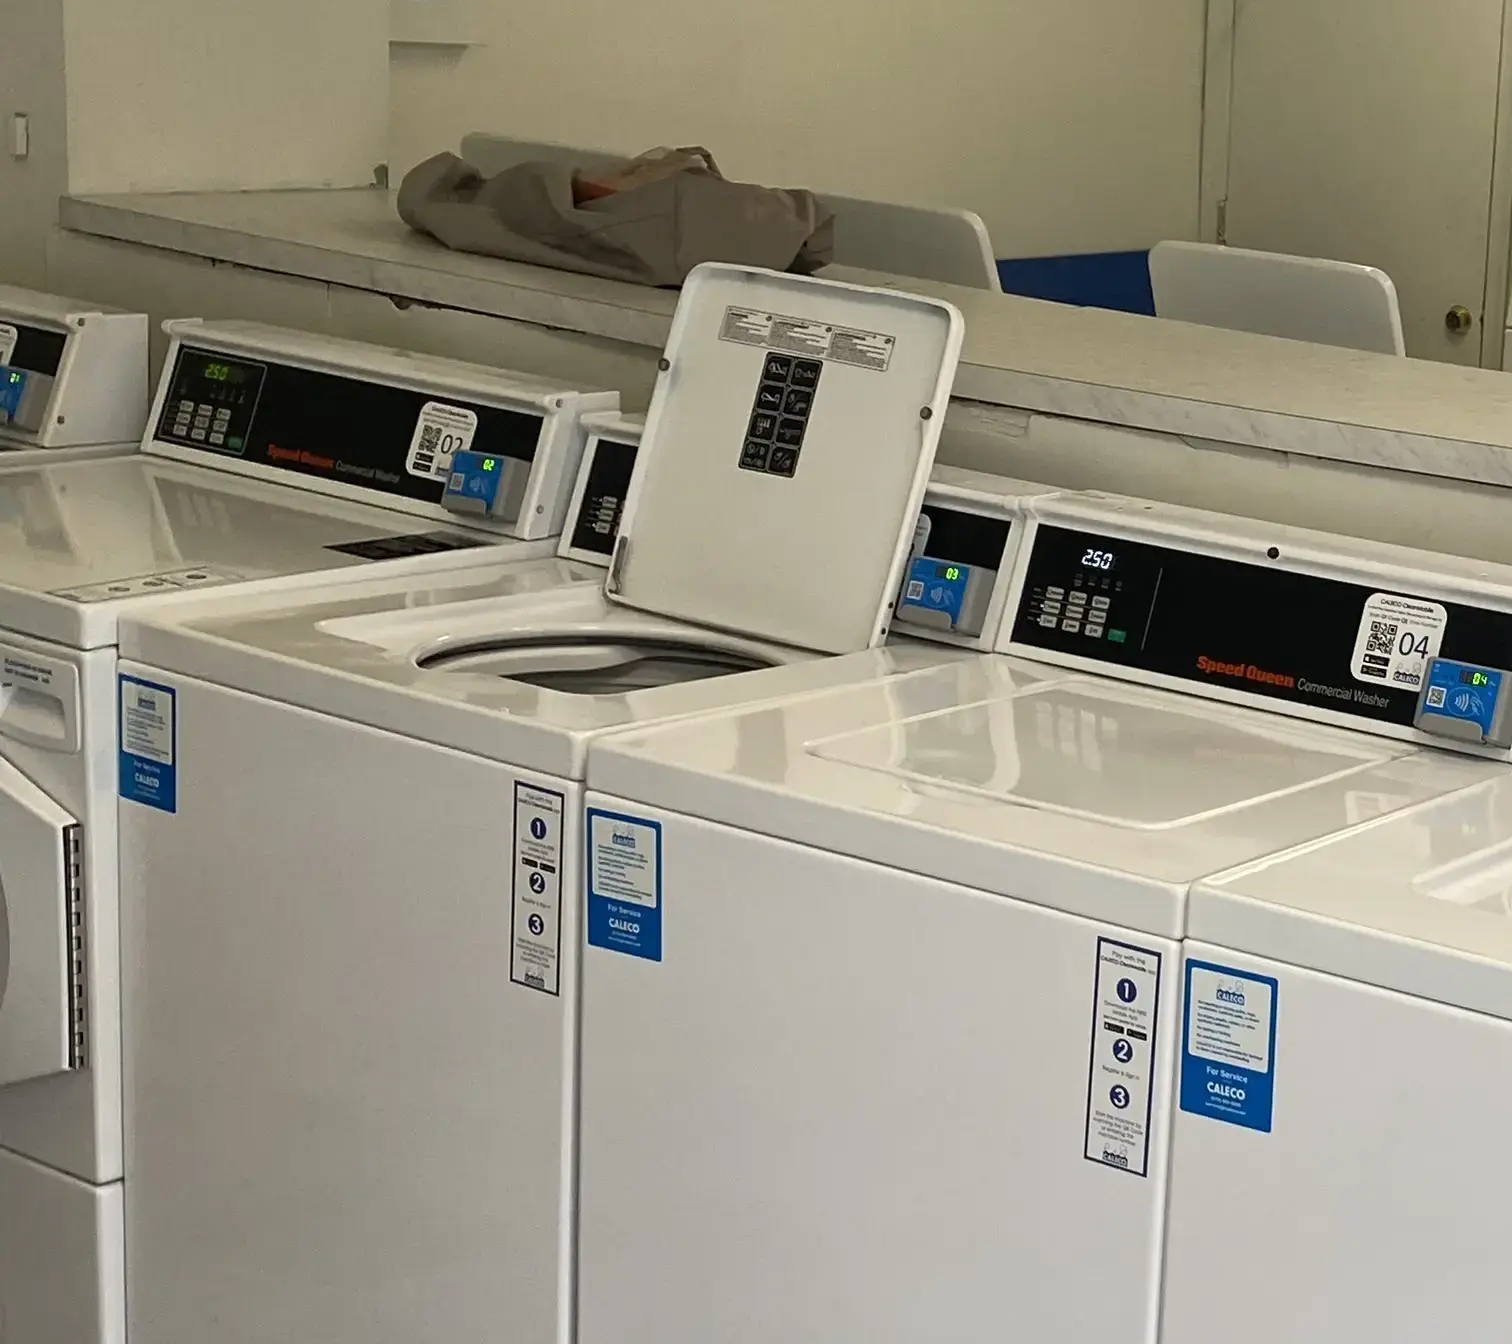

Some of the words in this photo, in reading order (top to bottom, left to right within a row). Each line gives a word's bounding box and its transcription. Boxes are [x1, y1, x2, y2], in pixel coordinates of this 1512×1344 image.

[441, 434, 463, 454] 02
[946, 568, 959, 580] 03
[1399, 632, 1429, 659] 04
[1197, 656, 1245, 677] Speed
[1246, 665, 1295, 689] Queen
[1297, 678, 1353, 700] Commercial
[1354, 689, 1390, 708] Washer
[1394, 672, 1419, 684] CALECO
[1472, 672, 1487, 685] 04
[535, 822, 541, 836] 1
[533, 874, 542, 891] 2
[532, 917, 541, 933] 3
[608, 918, 640, 934] CALECO
[1123, 982, 1129, 998] 1
[1217, 991, 1244, 1004] CALECO
[1117, 1042, 1129, 1060] 2
[1206, 1065, 1219, 1076] For
[1220, 1069, 1248, 1084] Service
[1113, 1088, 1125, 1106] 3
[1206, 1081, 1246, 1101] CALECO
